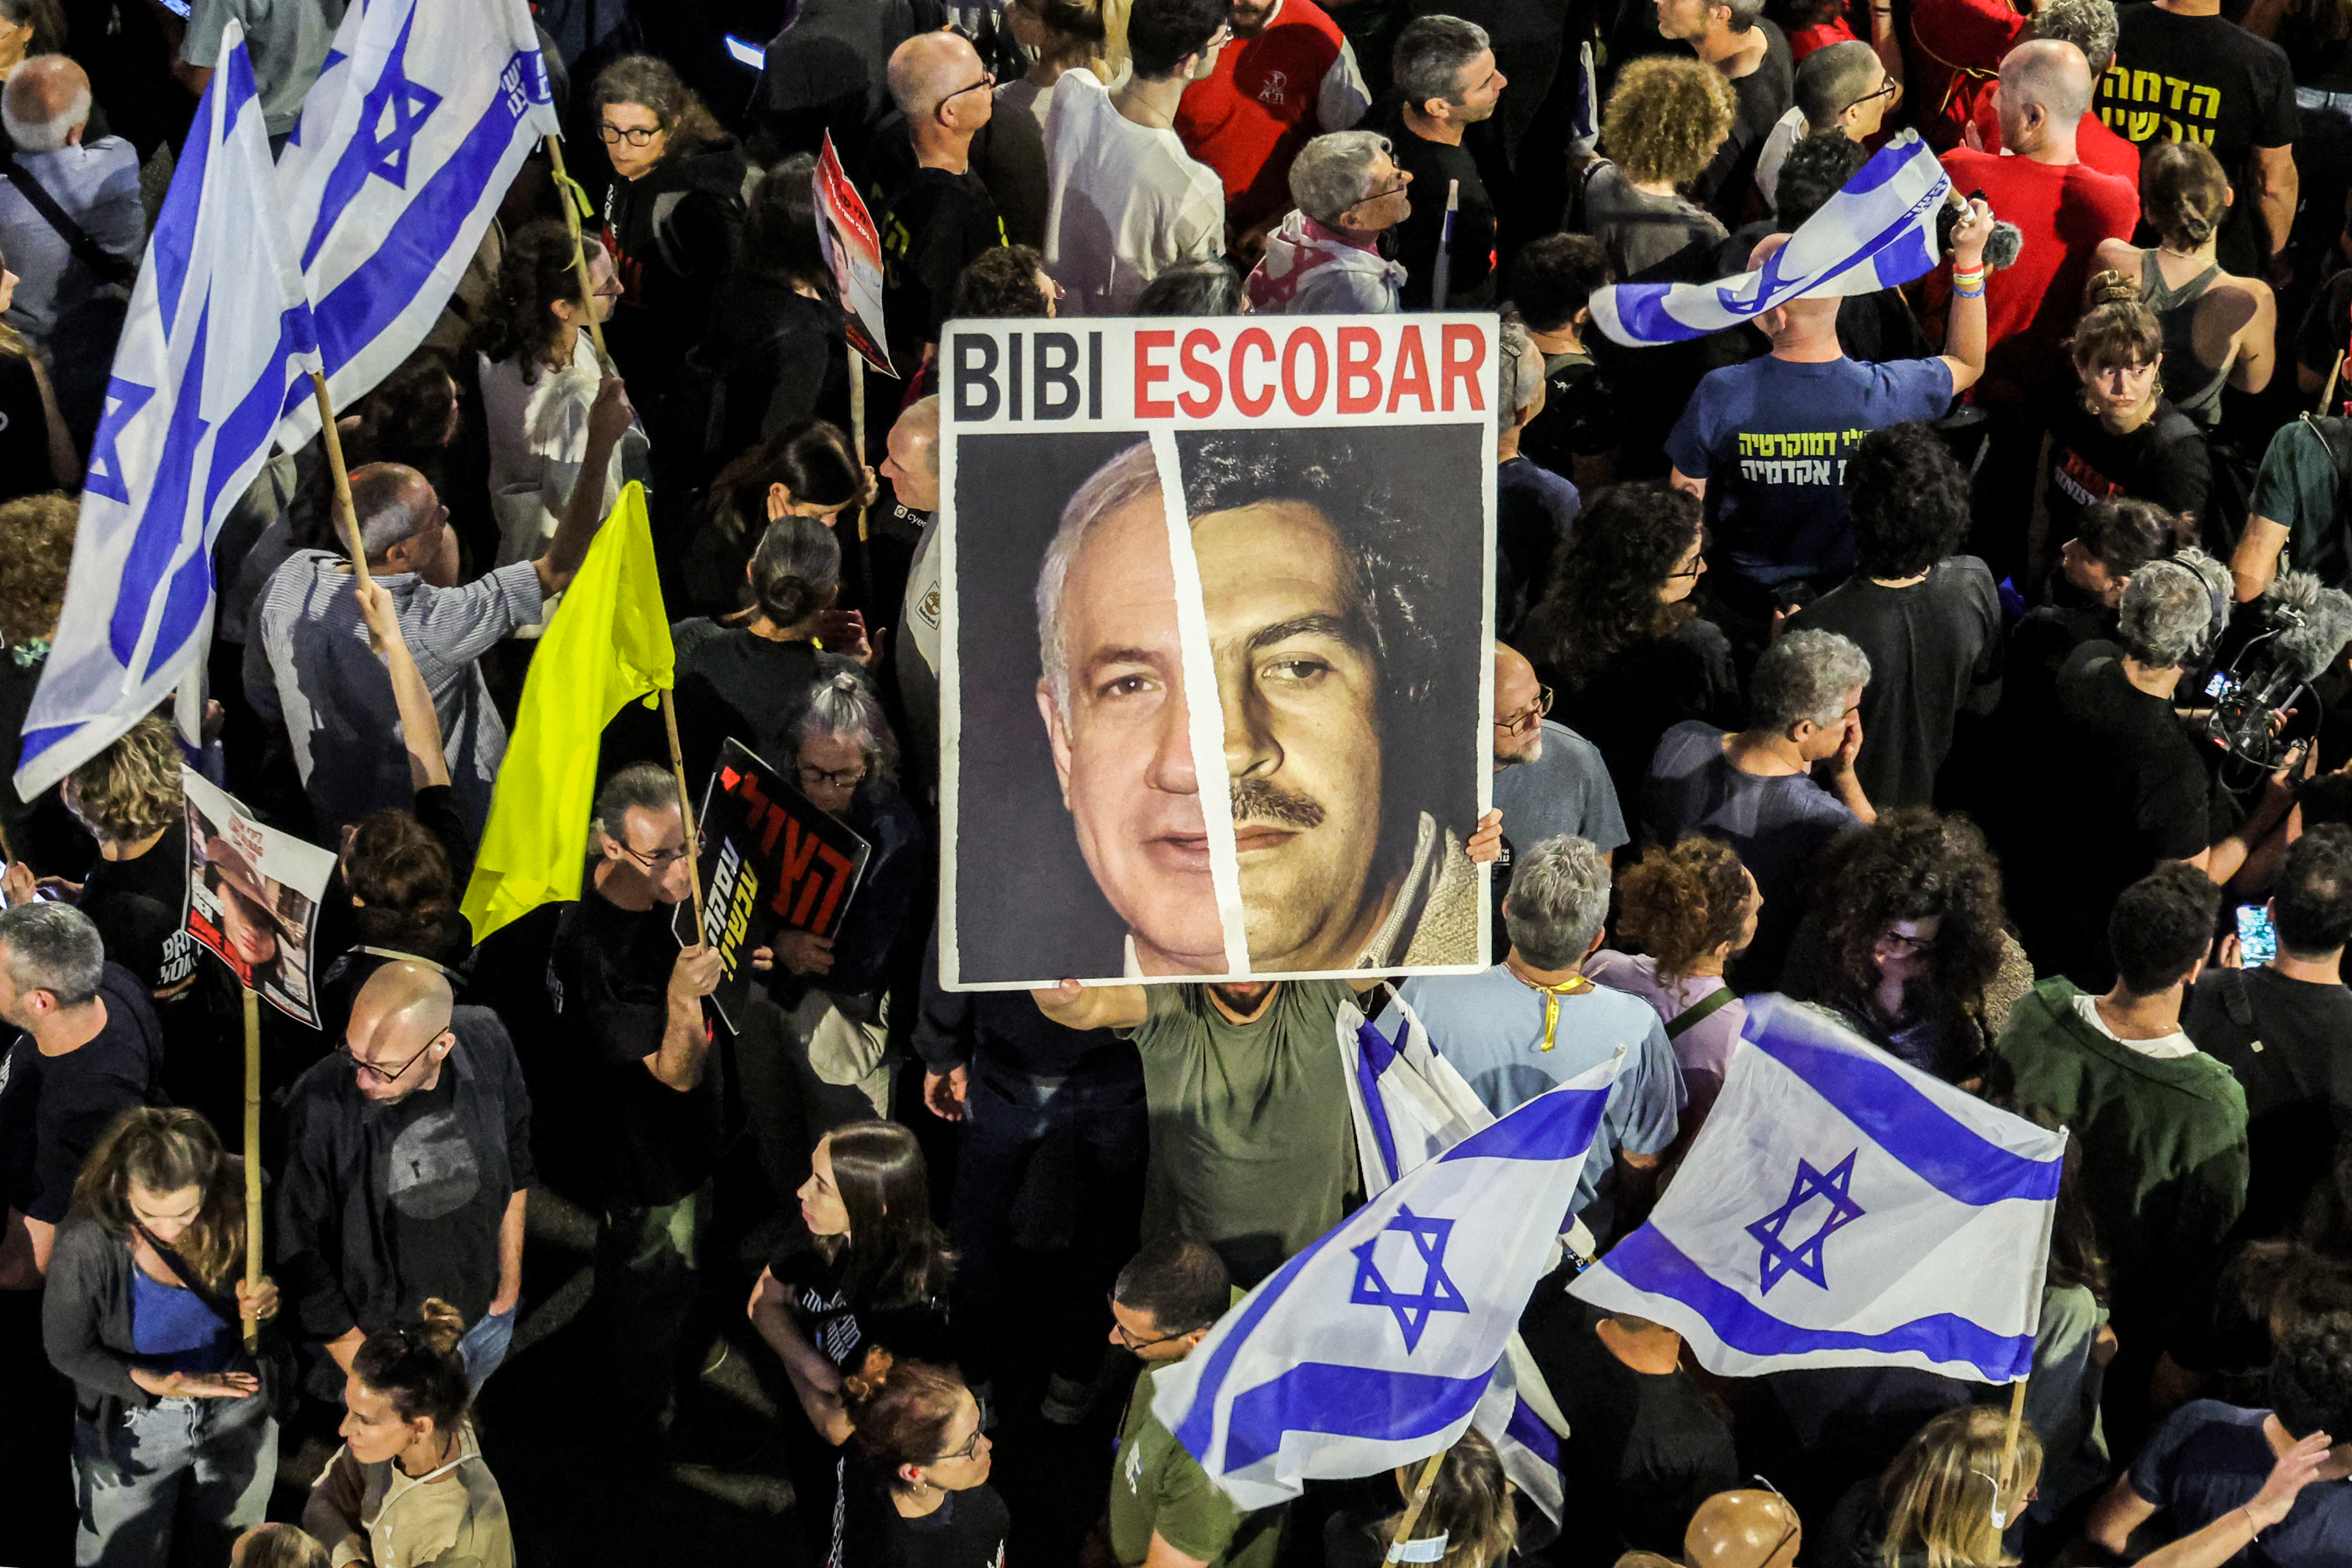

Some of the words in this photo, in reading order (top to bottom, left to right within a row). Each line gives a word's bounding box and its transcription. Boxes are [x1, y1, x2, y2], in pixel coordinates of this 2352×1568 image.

[2103, 66, 2221, 119] הדחה
[2102, 107, 2215, 148] עכשיו
[953, 332, 1102, 421] BIBI
[1135, 323, 1486, 418] ESCOBAR
[1739, 432, 1837, 458] דמוקרטיה
[1842, 428, 1873, 451] לי
[1741, 460, 1830, 485] אקדמיה
[705, 836, 740, 947] עסקה
